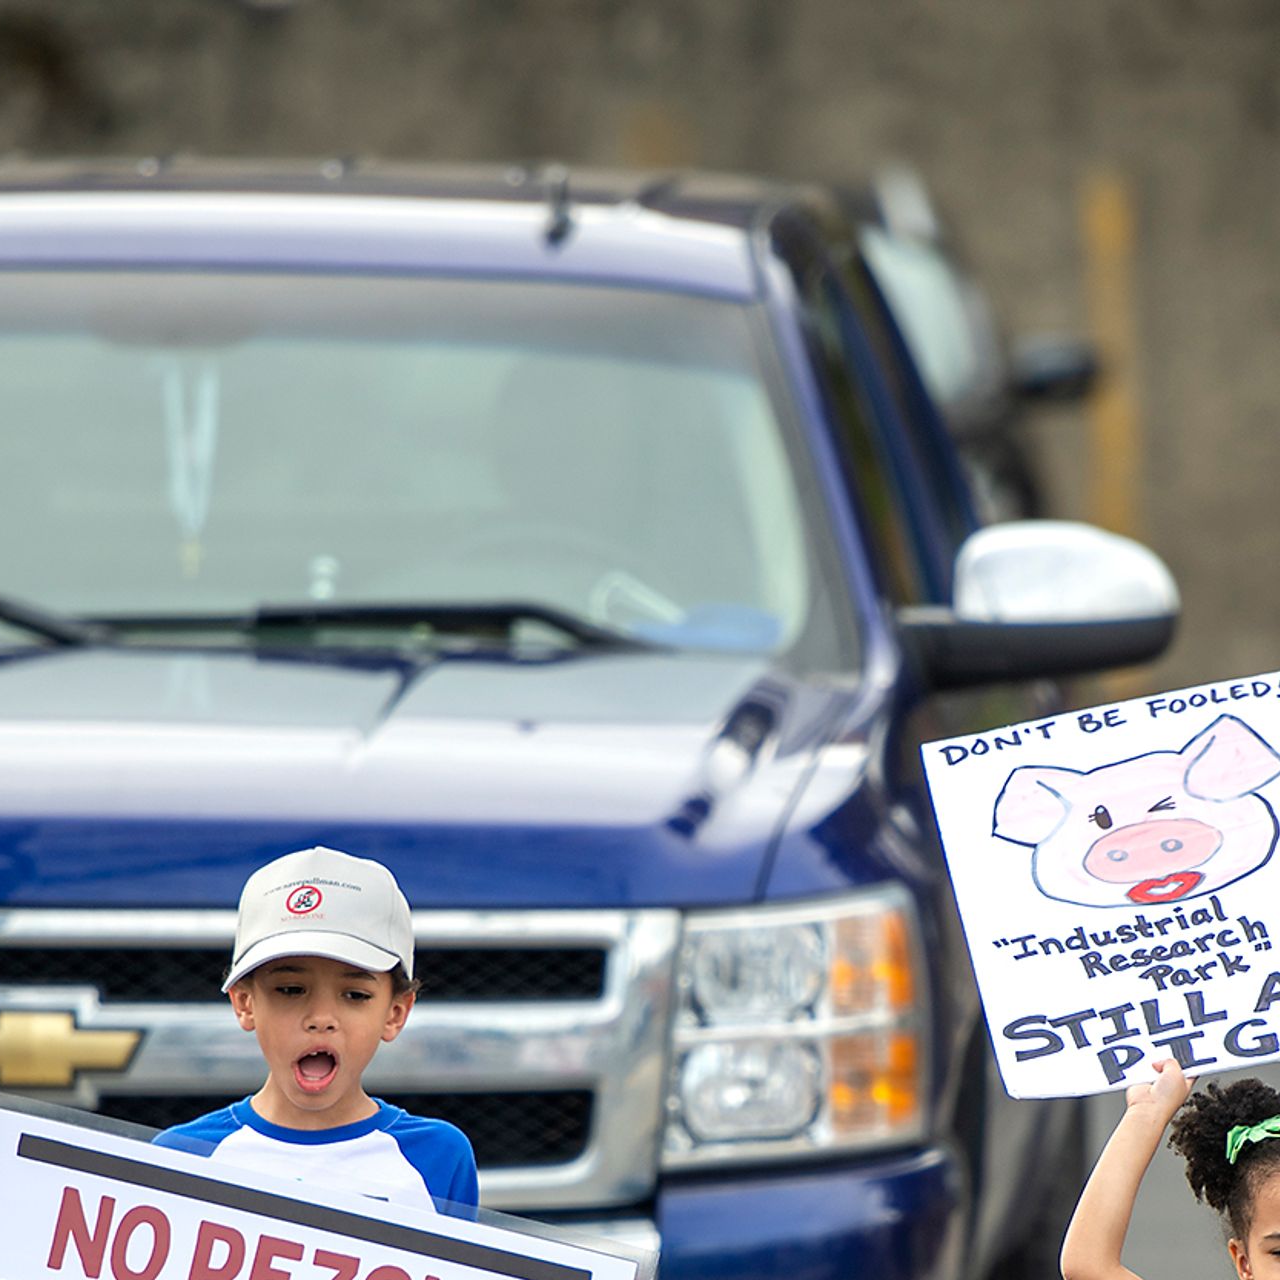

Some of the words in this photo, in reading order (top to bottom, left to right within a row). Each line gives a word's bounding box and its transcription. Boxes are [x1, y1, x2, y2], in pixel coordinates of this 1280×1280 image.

[939, 721, 1056, 766] DON'T
[1076, 708, 1128, 734] BE
[991, 895, 1229, 961] "Industrial
[1078, 915, 1270, 979] Research
[1002, 991, 1228, 1063] STILL
